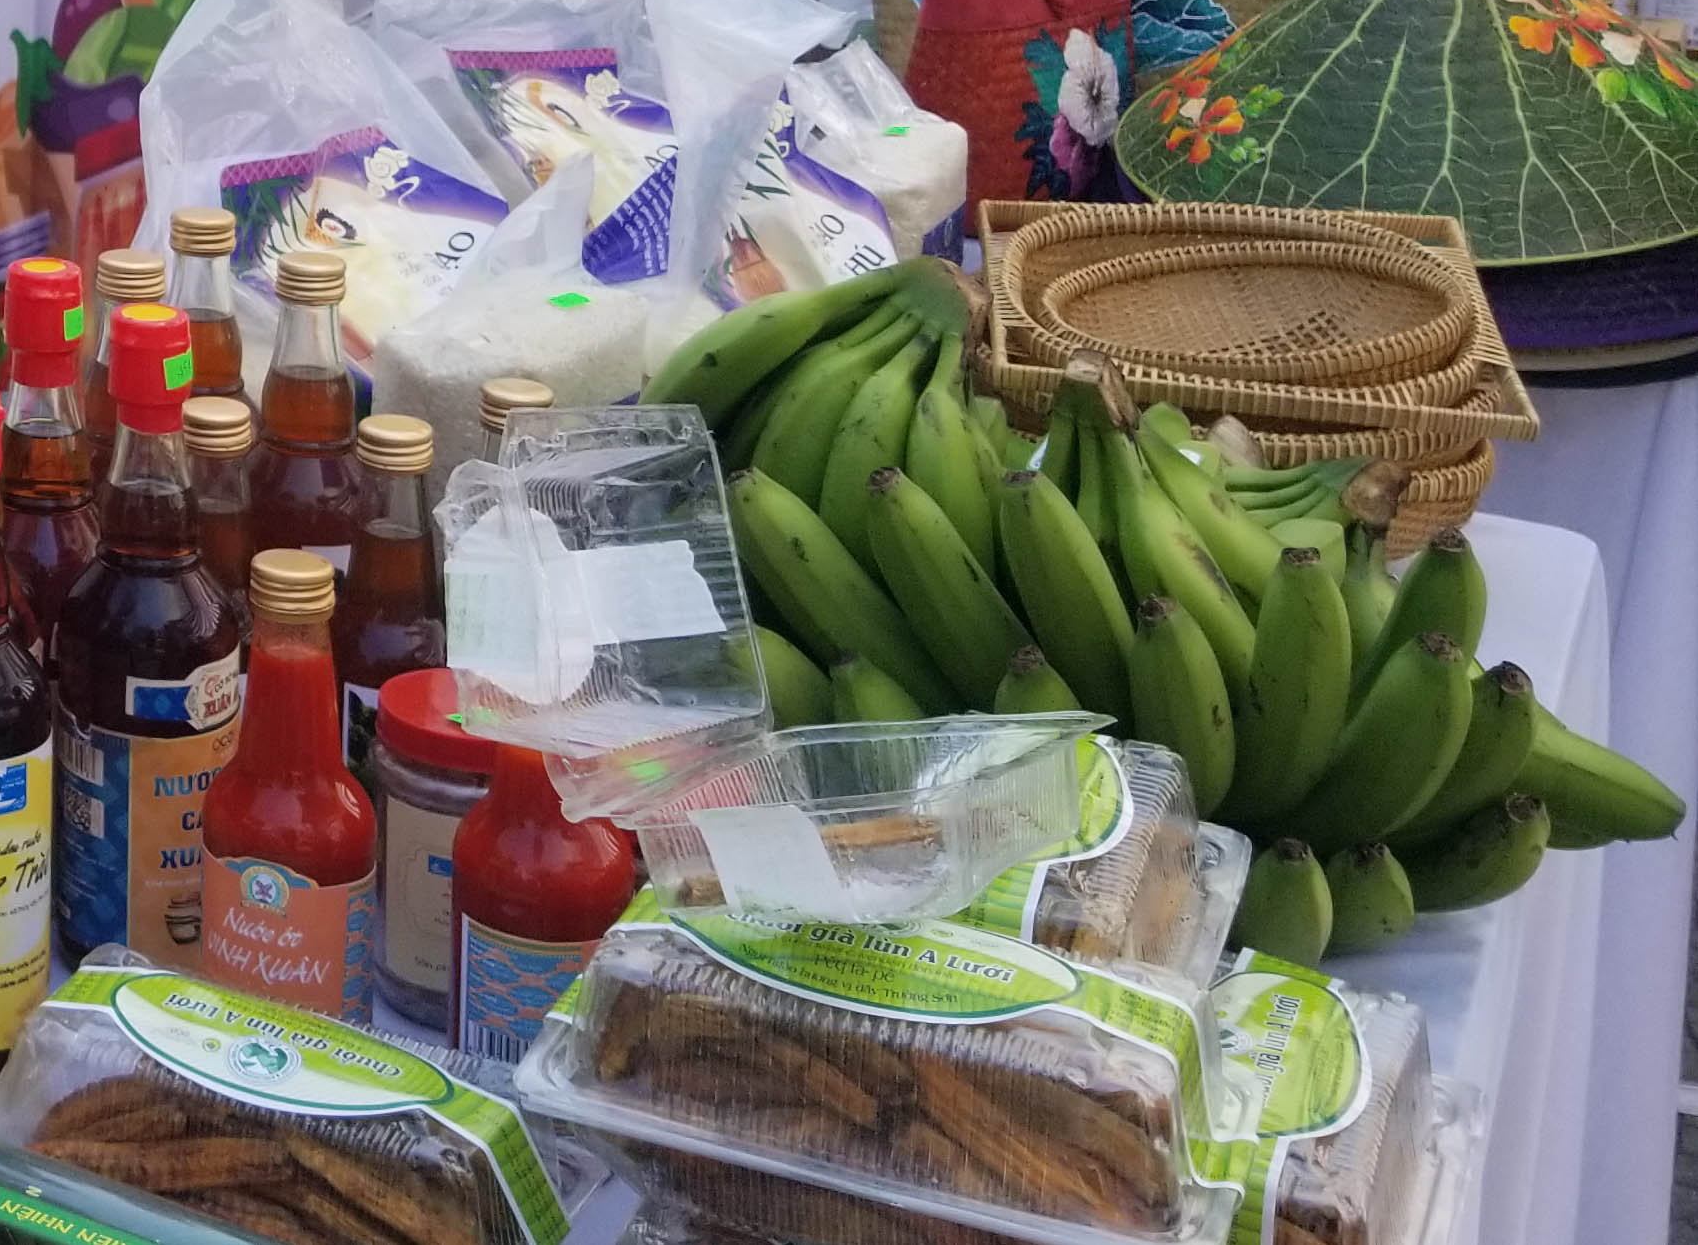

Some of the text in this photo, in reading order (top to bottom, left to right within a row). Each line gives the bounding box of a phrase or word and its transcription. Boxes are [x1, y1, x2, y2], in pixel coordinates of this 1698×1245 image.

[223, 907, 276, 945] Nước
[918, 948, 940, 965] A
[947, 954, 1014, 983] Lưới
[223, 1010, 243, 1024] A
